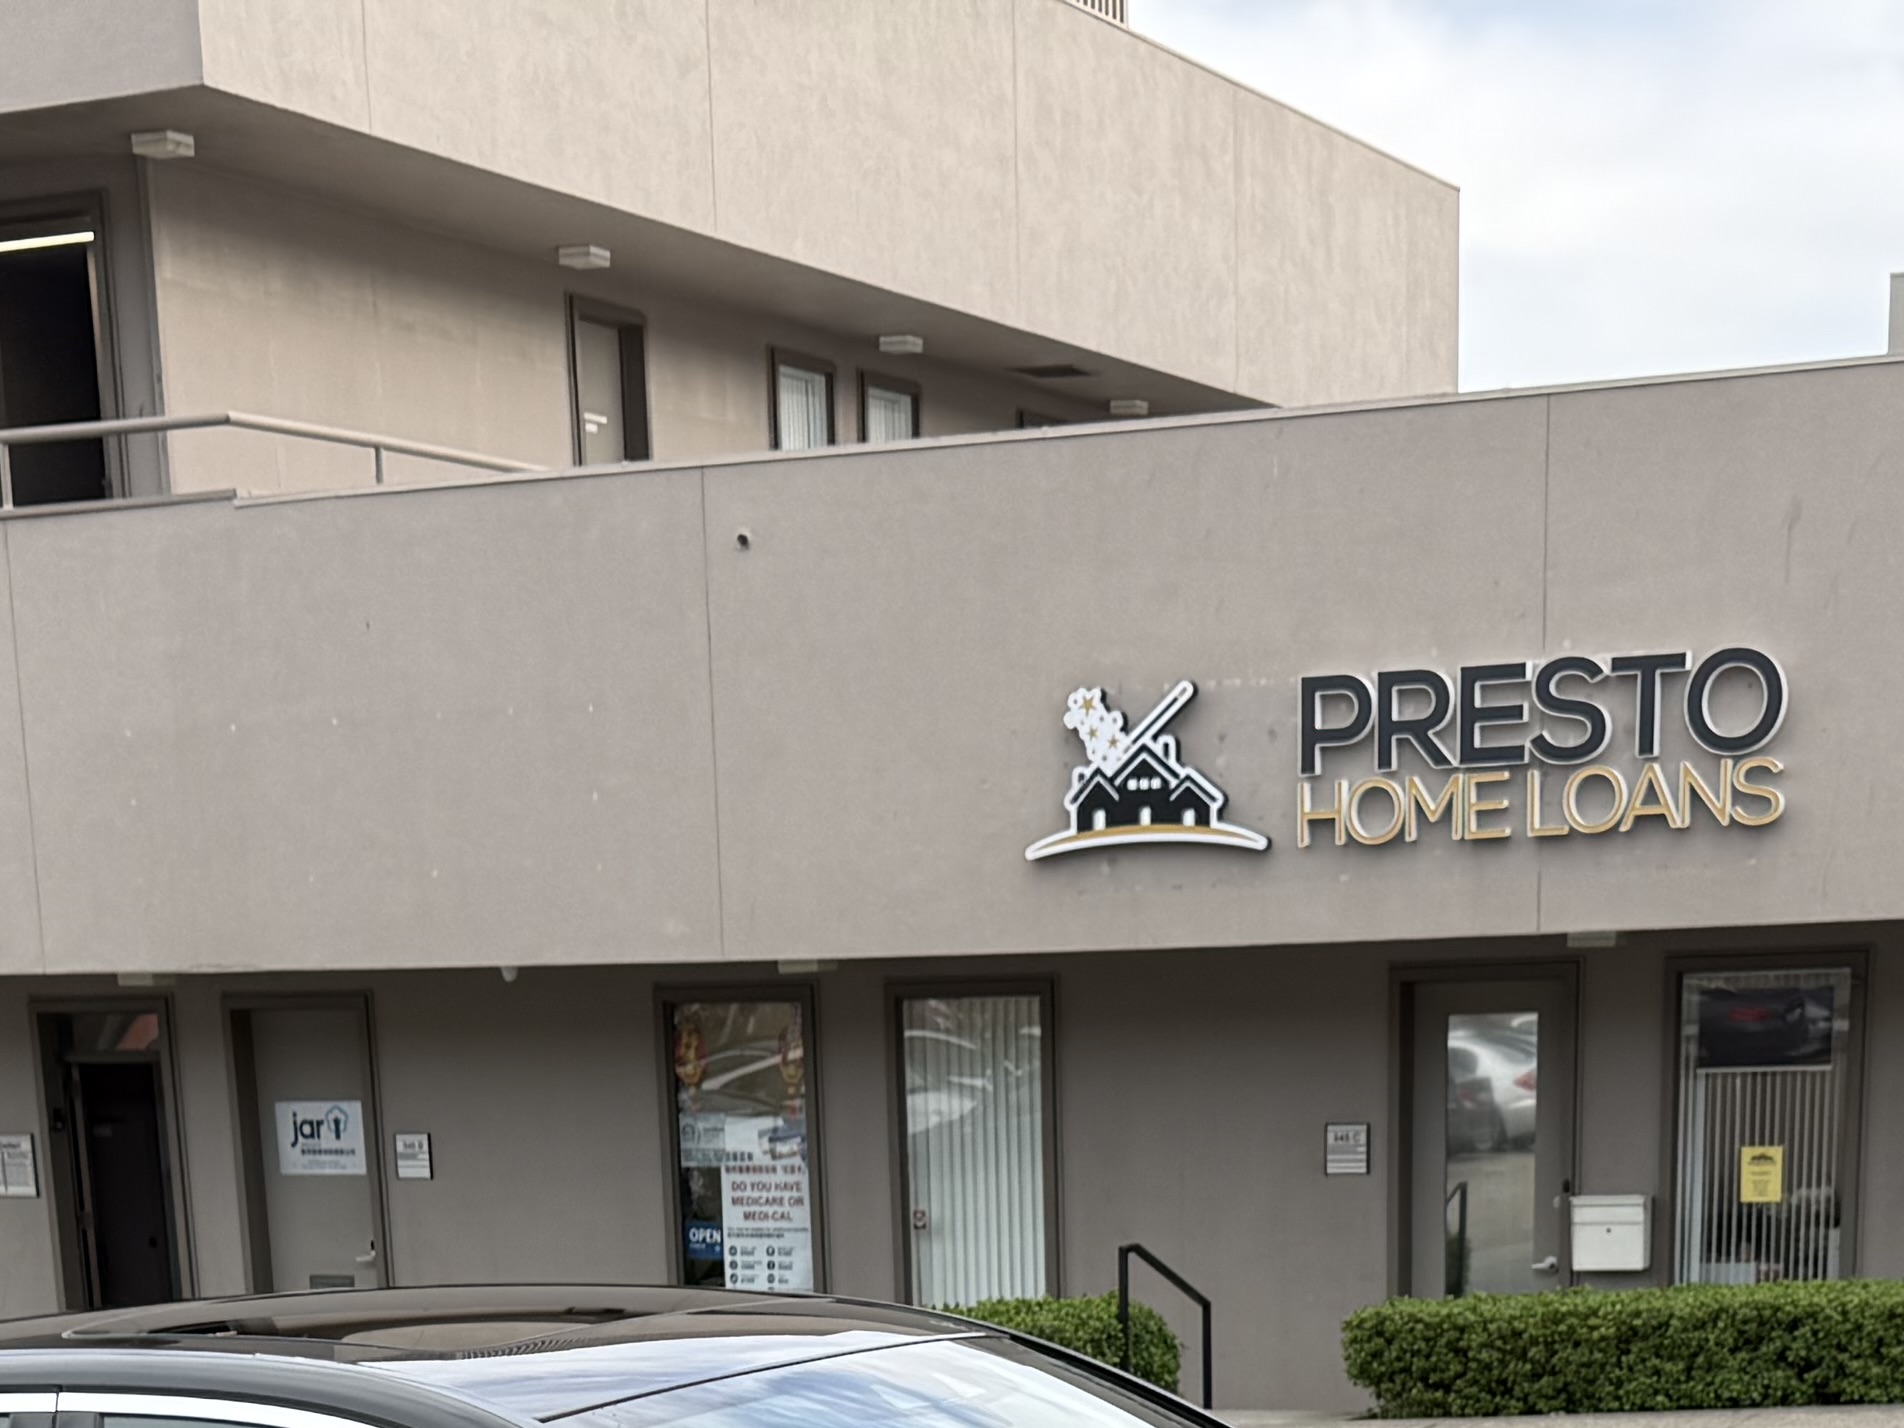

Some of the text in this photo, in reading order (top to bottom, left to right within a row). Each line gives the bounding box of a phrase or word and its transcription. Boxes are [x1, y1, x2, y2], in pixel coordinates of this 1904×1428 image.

[1299, 646, 1789, 776] PRESTO
[1297, 756, 1786, 849] HOME LOANS
